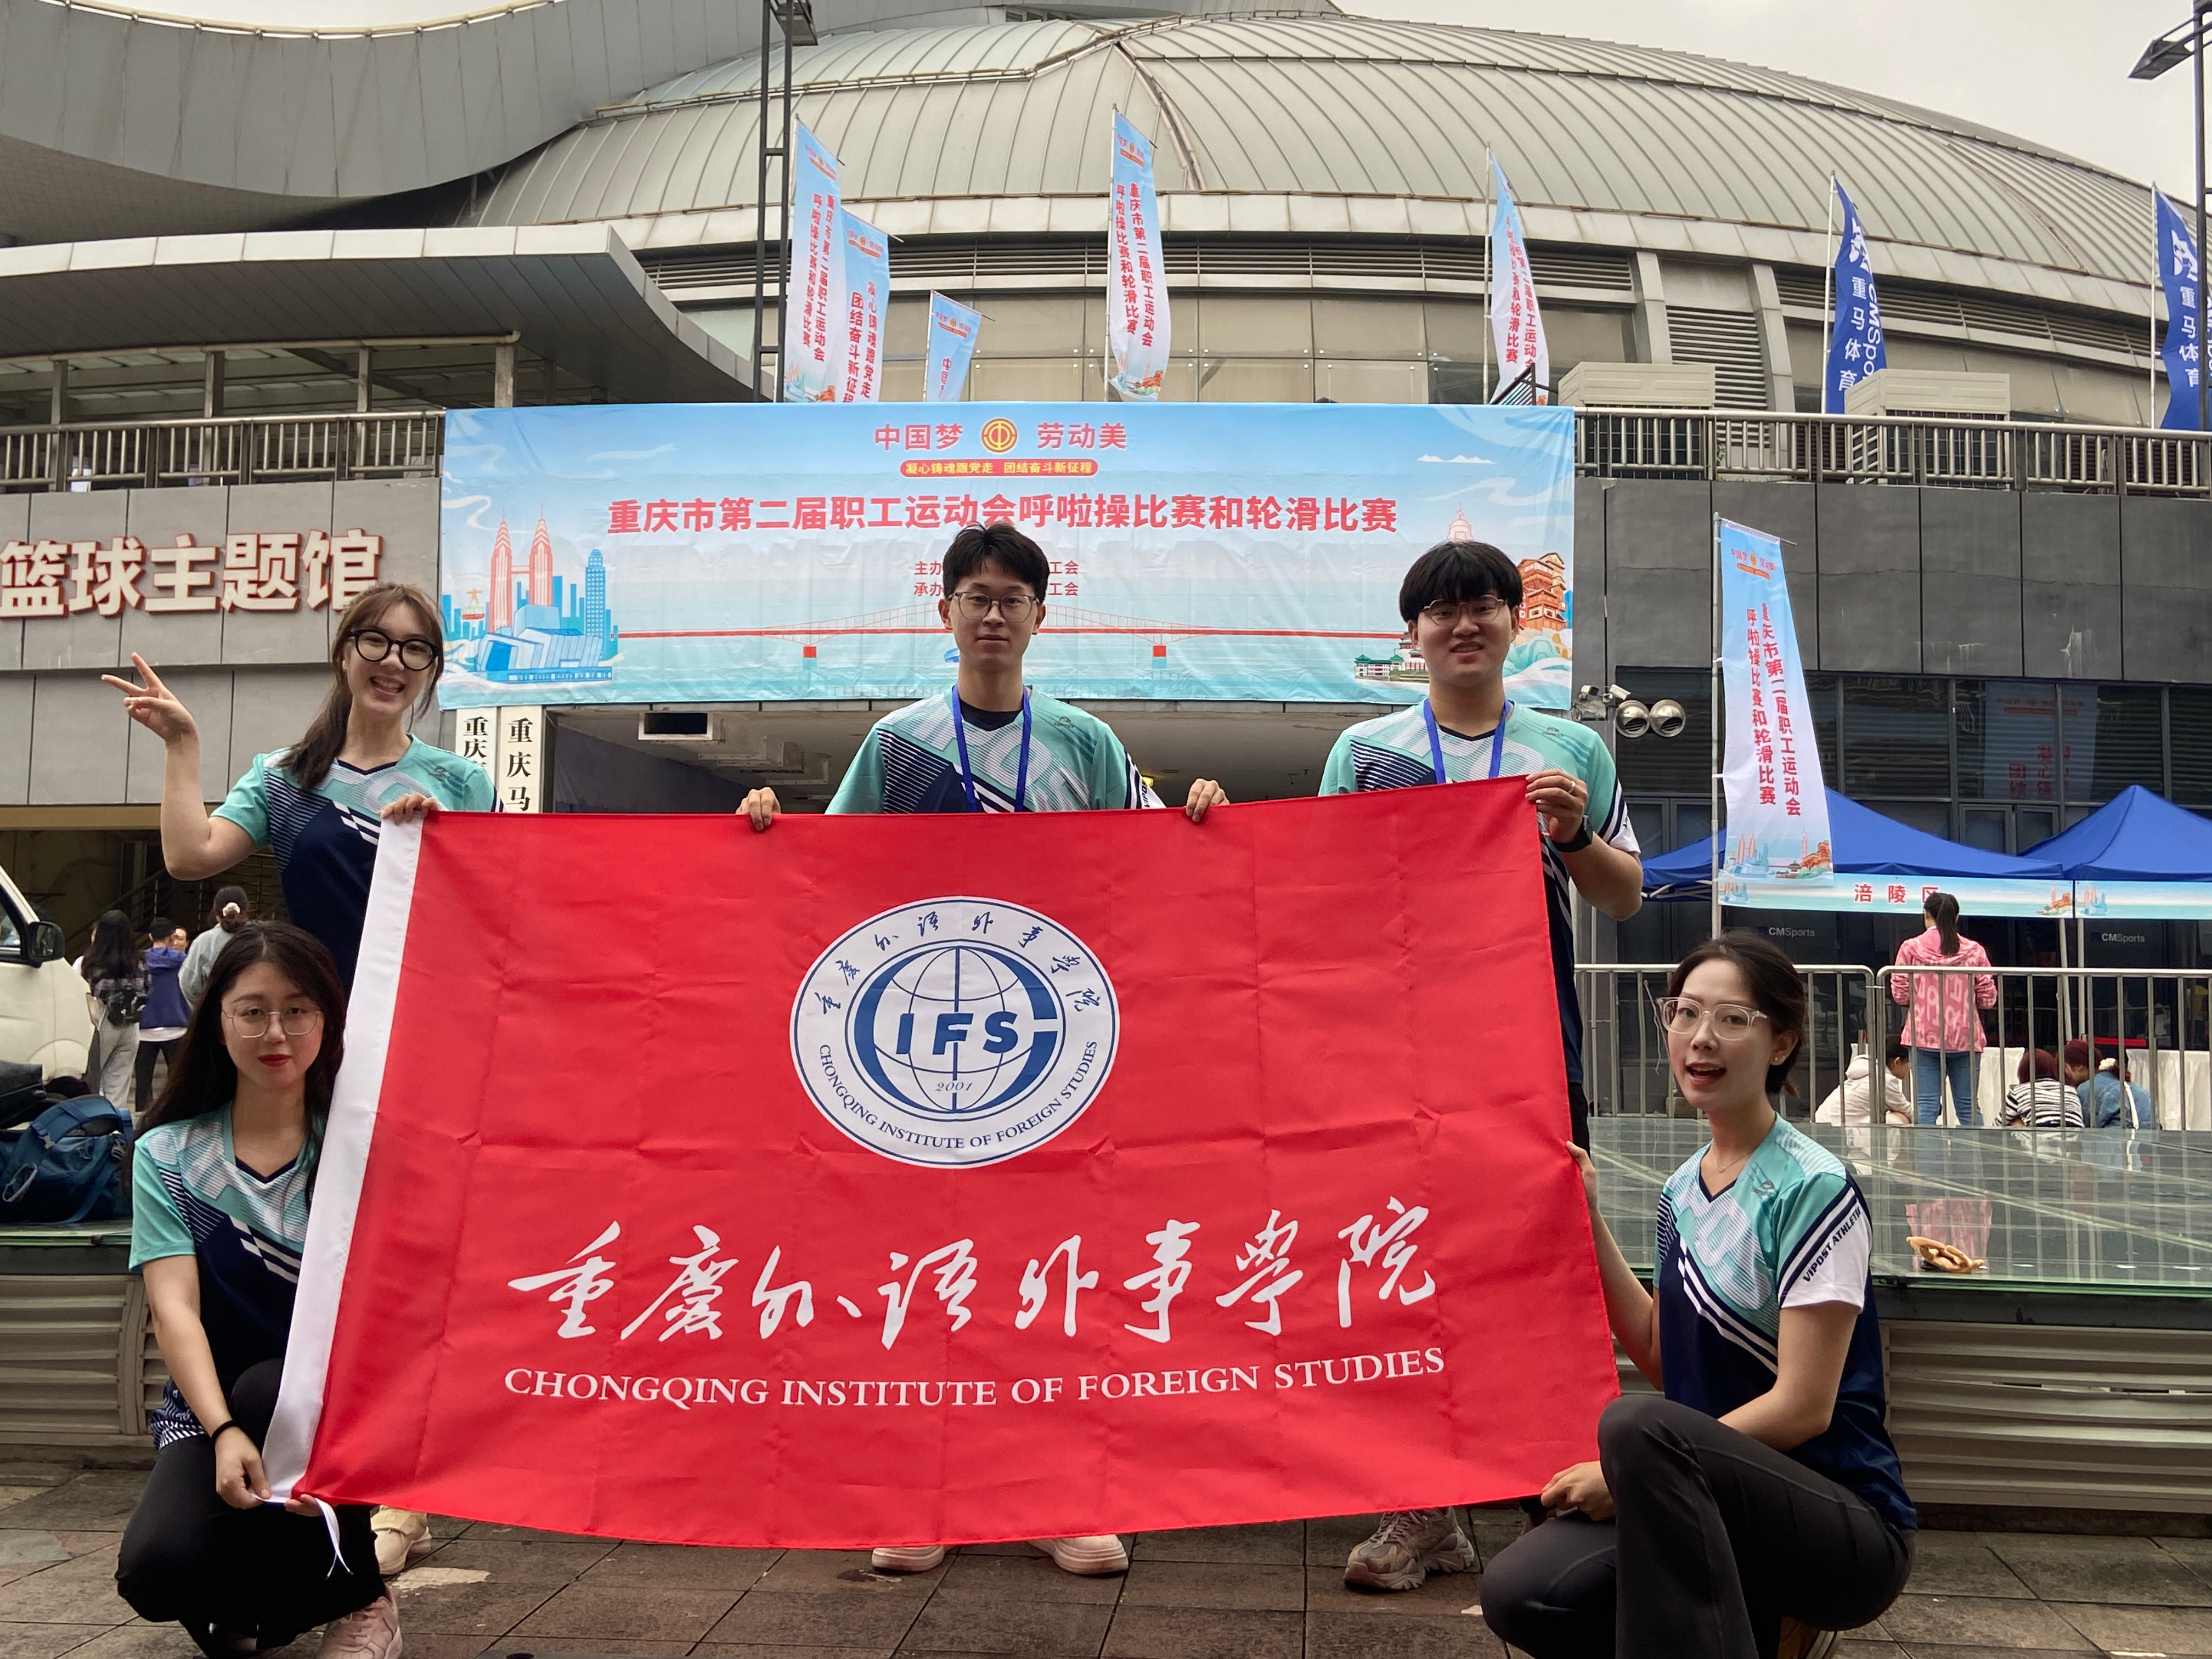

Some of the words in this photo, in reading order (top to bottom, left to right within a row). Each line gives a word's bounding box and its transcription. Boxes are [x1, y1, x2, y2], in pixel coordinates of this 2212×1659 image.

[1116, 184, 1139, 334] 呼啦操比赛和轮滑比赛
[1130, 183, 1155, 347] 重庆市第二届职工运动会
[1863, 283, 1881, 380] CMSpo
[874, 423, 963, 451] 中国梦
[1037, 422, 1126, 450] 劳动美
[906, 462, 994, 474] 凝心铸魂跟党走
[1004, 462, 1092, 474] 团结奋斗新征程
[607, 493, 1397, 534] 重庆市第二届职工运动会呼啦操比赛和轮滑比赛
[0, 528, 383, 619] 篮球主题馆
[1048, 582, 1079, 596] 工会
[1747, 608, 1776, 805] 呼啦操比赛和轮滑比赛
[1762, 602, 1801, 816] 重庆市第二届职工运动会
[505, 718, 534, 811] 重庆马
[1768, 927, 1815, 939] CMSports
[2102, 933, 2145, 944] CMSports
[819, 1044, 878, 1126] CHONGQING
[878, 1121, 964, 1148] INSTITUTE
[970, 1134, 992, 1148] OF
[996, 1098, 1062, 1142] FOREIGN
[1060, 1041, 1098, 1100] STUDIES
[935, 1082, 973, 1092] 2001
[1803, 1242, 1832, 1282] VIPOST
[505, 1368, 769, 1410] CHONGQING
[781, 1379, 996, 1406] INSTITUTE
[1011, 1377, 1062, 1404] OF
[1079, 1365, 1259, 1401] FOREIGN
[1275, 1347, 1445, 1389] STUDIES
